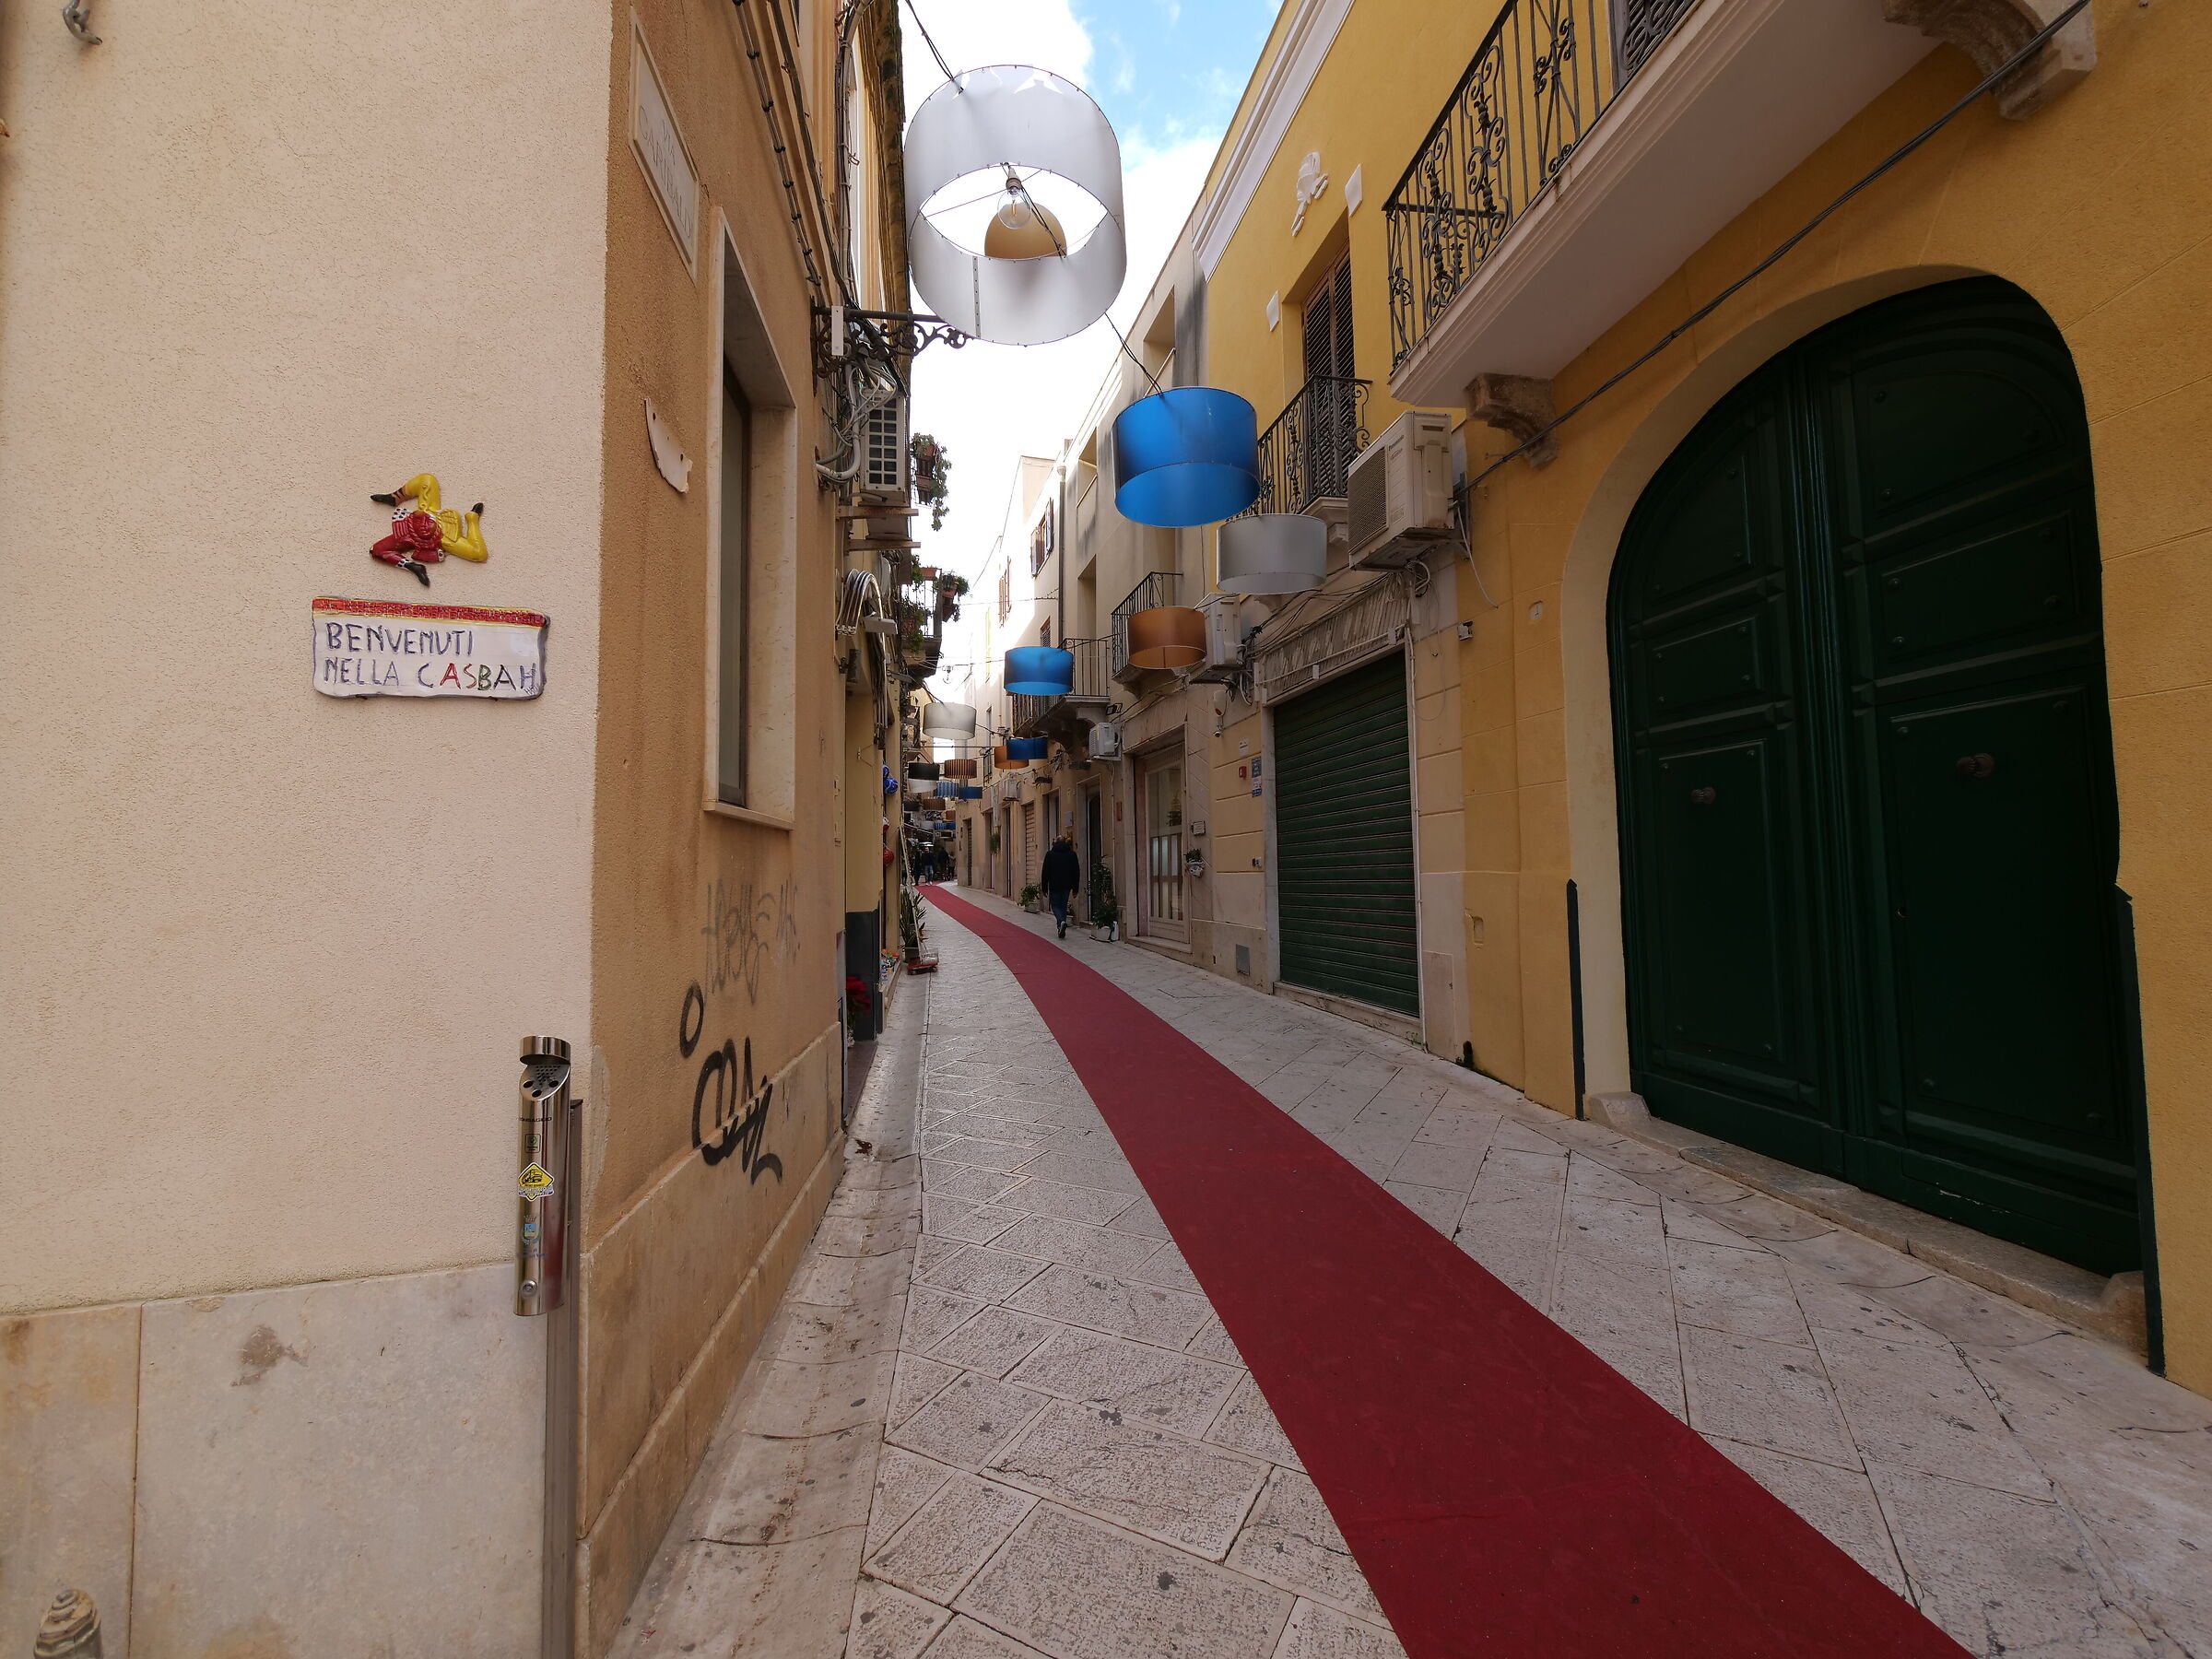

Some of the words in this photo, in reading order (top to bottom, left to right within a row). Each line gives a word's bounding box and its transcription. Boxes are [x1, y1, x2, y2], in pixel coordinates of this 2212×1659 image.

[661, 118, 677, 167] VIA
[325, 621, 474, 656] BENVENUTI
[324, 656, 399, 687] NELLA
[417, 662, 536, 691] CASBAH
